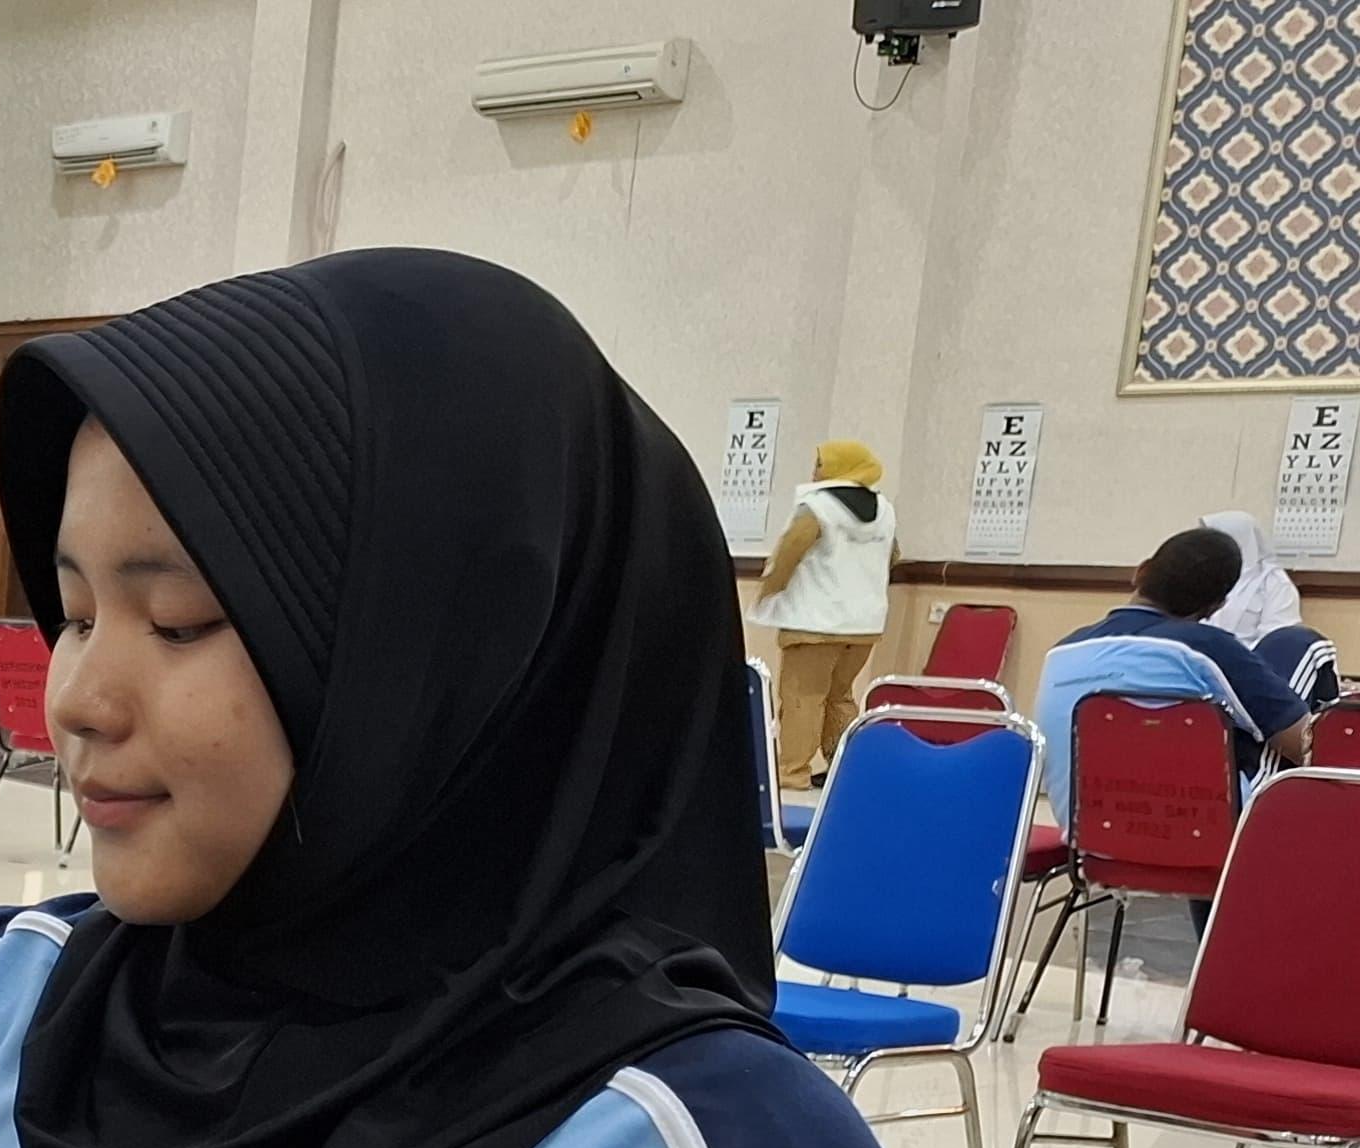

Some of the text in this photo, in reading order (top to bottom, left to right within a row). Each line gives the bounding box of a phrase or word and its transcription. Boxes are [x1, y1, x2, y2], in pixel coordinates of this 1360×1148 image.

[745, 410, 765, 429] E
[1312, 405, 1339, 427] E
[1002, 416, 1024, 435] E
[730, 434, 767, 449] N Z
[985, 440, 1027, 456] N Z
[1291, 433, 1342, 450] N Z
[728, 453, 767, 465] Y L V
[1286, 454, 1343, 469] Y L V
[981, 461, 1028, 474] Y L V
[977, 478, 984, 487] U
[1282, 474, 1292, 483] U
[1315, 473, 1323, 483] V
[1329, 474, 1339, 483] P
